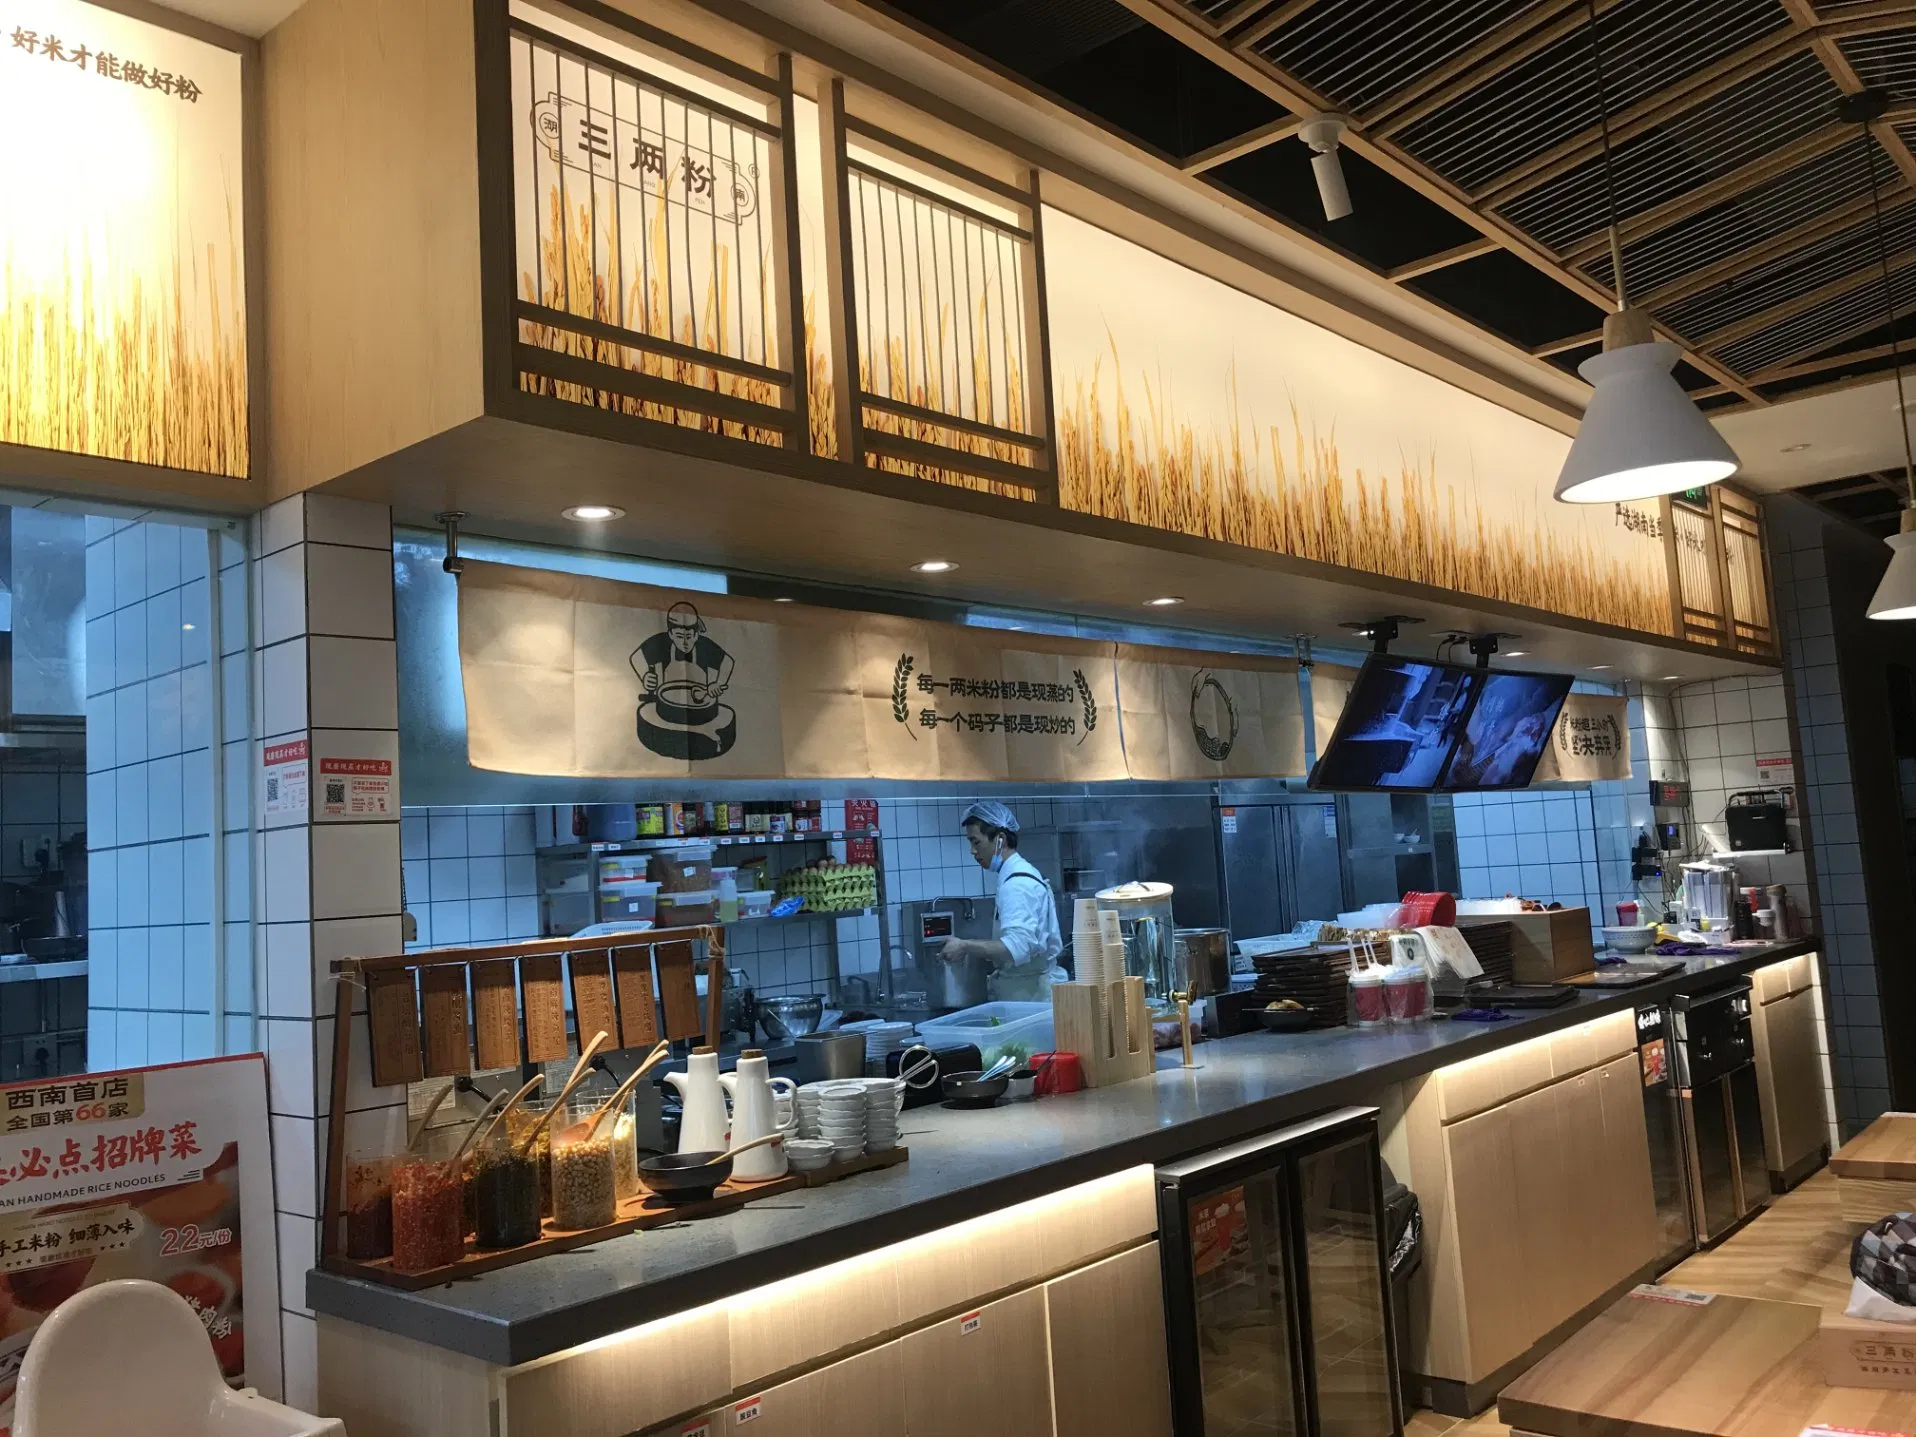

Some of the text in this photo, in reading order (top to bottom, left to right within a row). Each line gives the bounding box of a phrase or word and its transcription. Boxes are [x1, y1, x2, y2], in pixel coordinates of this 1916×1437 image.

[10, 26, 203, 103] 好米才能做好粉
[578, 119, 717, 199] 三两粉
[917, 672, 1074, 703] 每一两米粉都是现蒸的
[919, 708, 1076, 736] 每一个码子都是现炒的
[6, 1078, 129, 1110] 西南首店
[6, 1102, 129, 1131] 全国第66家
[17, 1186, 85, 1205] HANDMADE
[88, 1181, 112, 1194] RICE
[114, 1173, 166, 1188] NOODLES
[69, 1218, 134, 1245] 细薄入味
[160, 1223, 232, 1257] 22元/份
